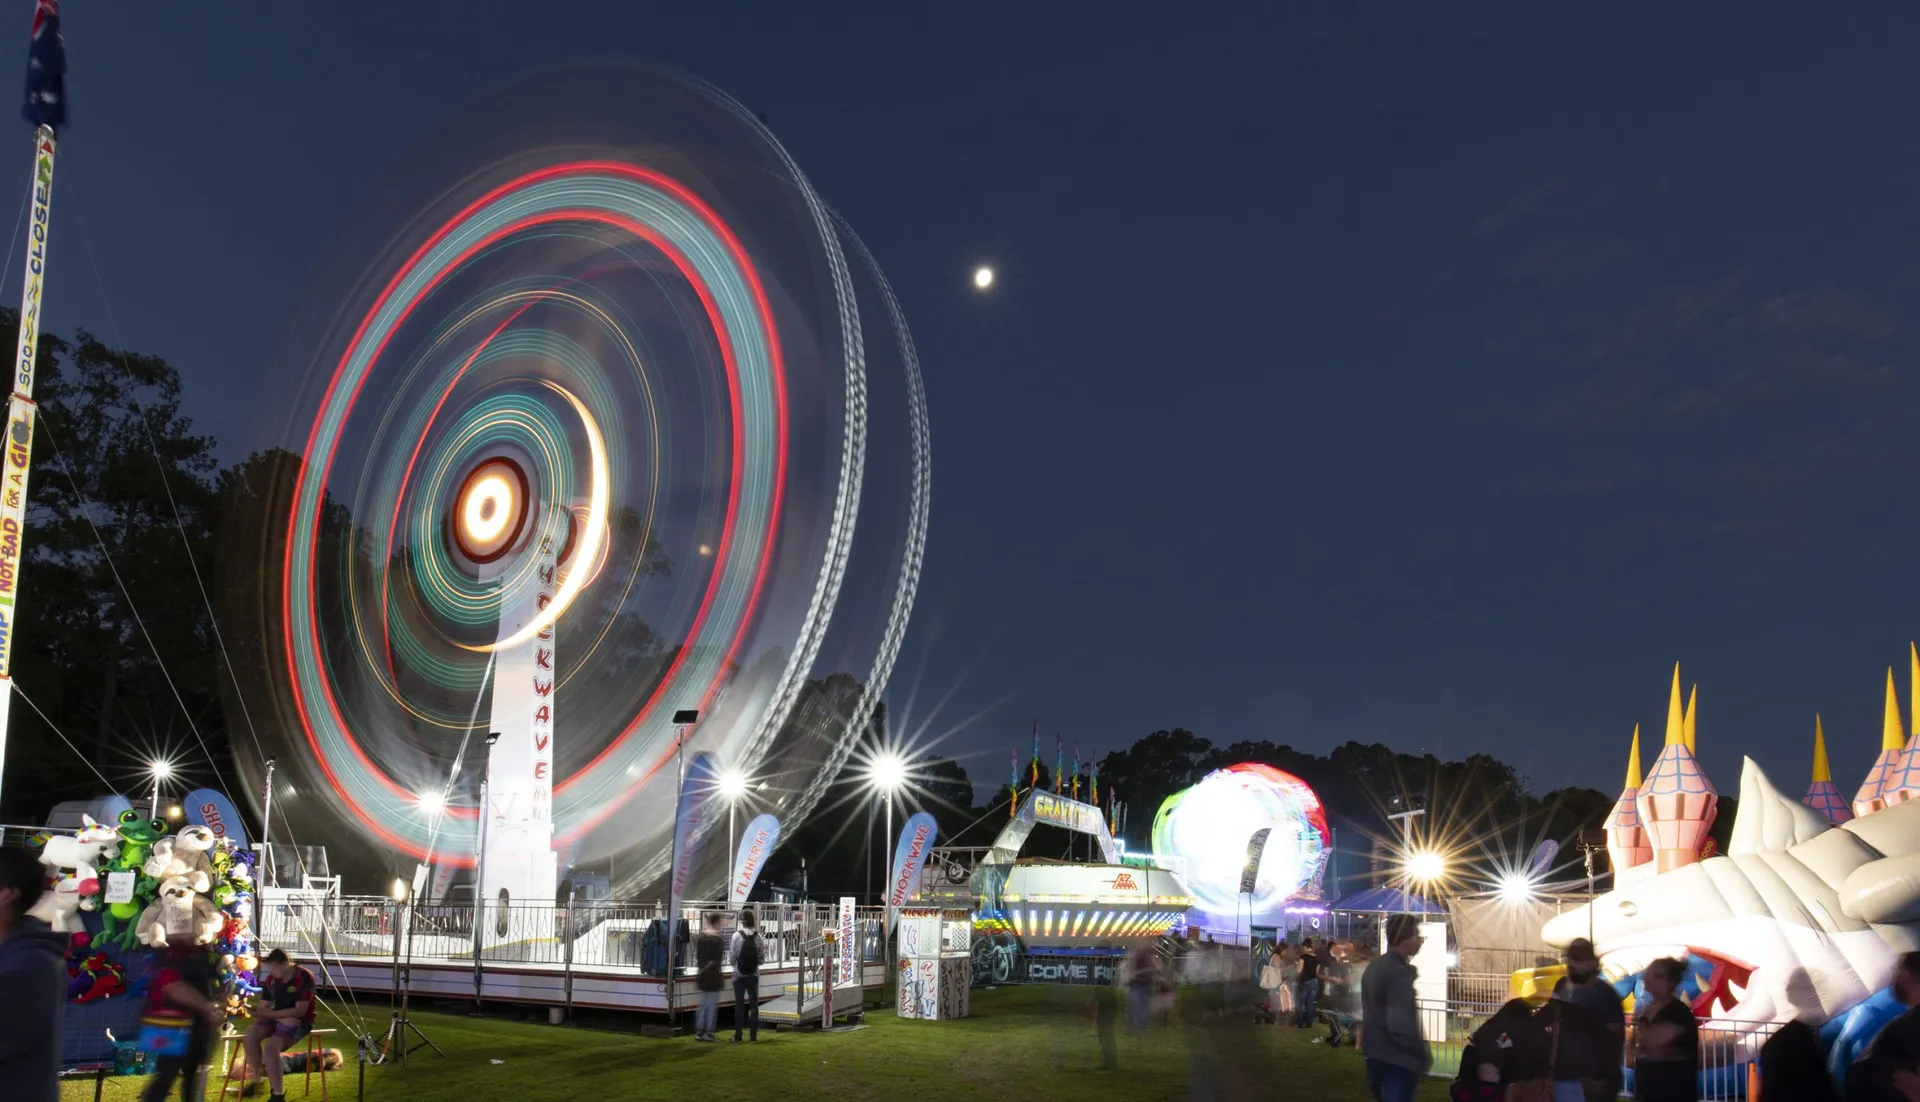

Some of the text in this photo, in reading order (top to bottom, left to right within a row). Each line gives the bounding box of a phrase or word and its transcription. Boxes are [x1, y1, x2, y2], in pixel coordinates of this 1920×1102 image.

[30, 185, 50, 276] CLOSE
[10, 474, 21, 485] A
[6, 490, 19, 509] FOR
[1, 518, 18, 557] BAD
[0, 558, 13, 593] NOT
[533, 535, 555, 781] SHOCKWAVE
[200, 802, 226, 838] SHO
[735, 828, 769, 896] FLAHERTY
[891, 823, 930, 907] SHOCKWAVE
[1028, 963, 1088, 979] COME
